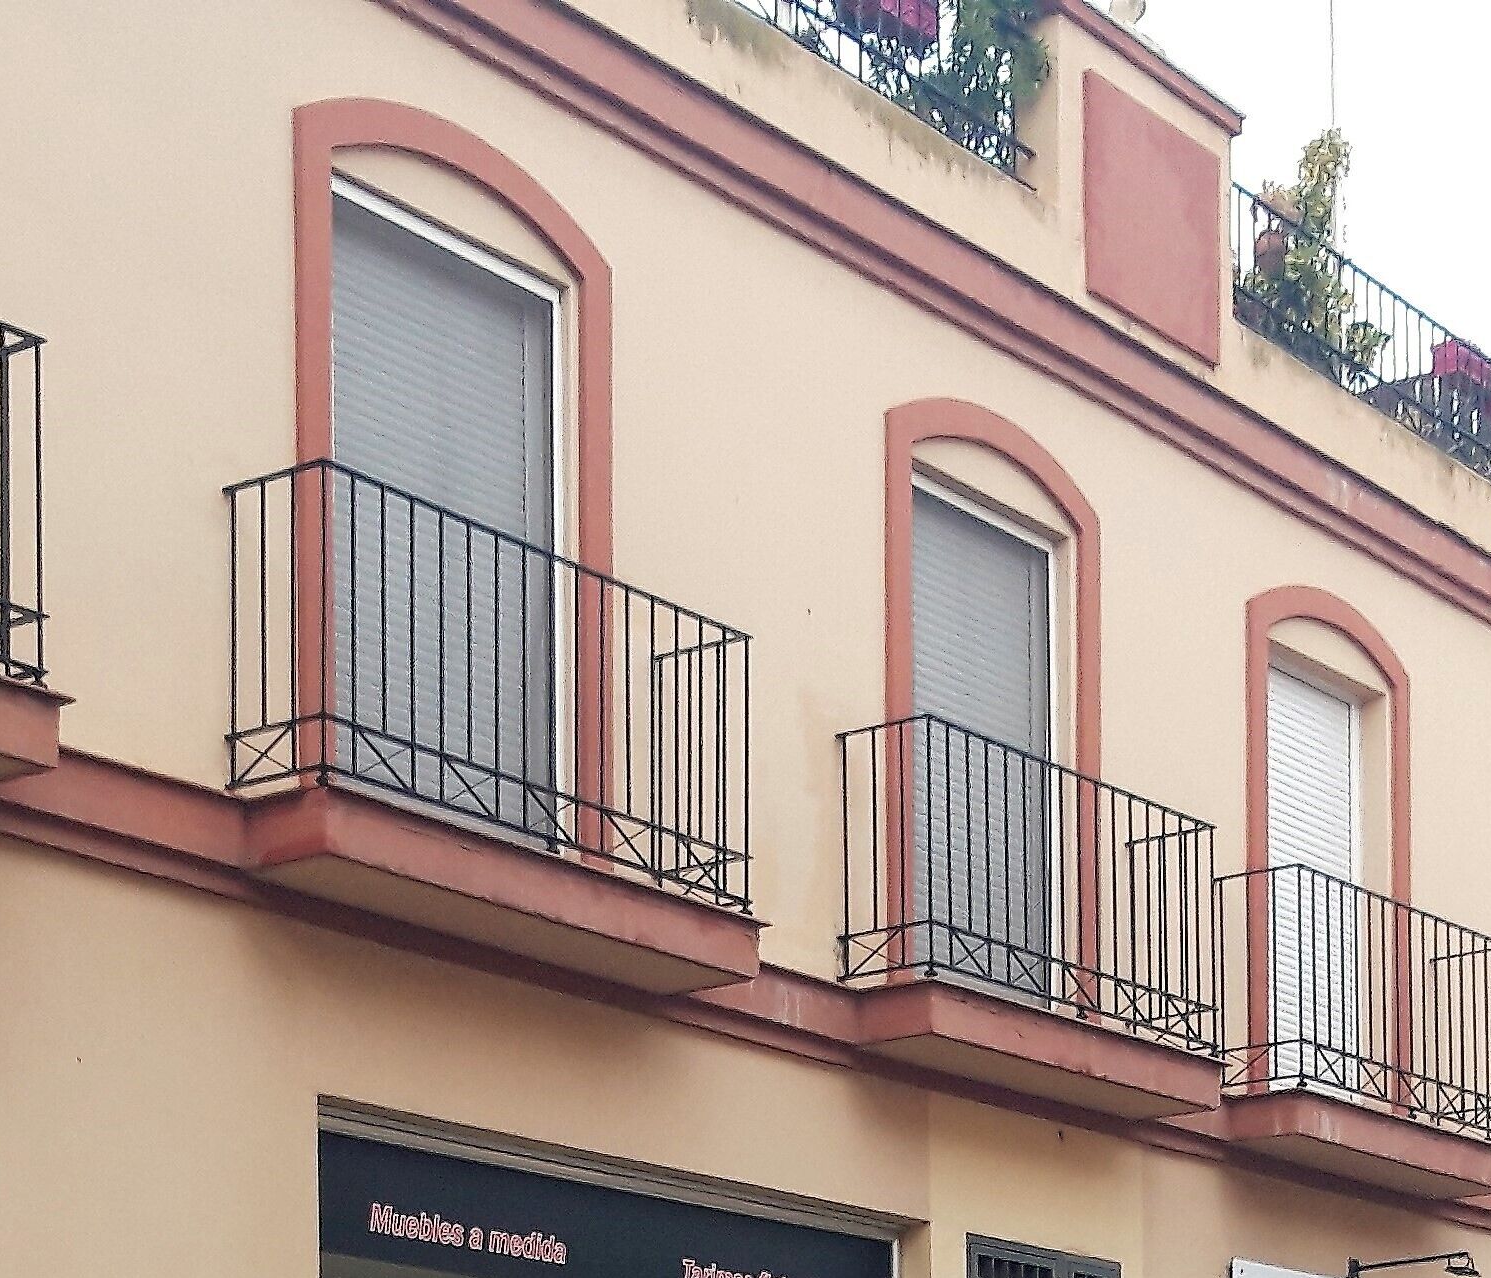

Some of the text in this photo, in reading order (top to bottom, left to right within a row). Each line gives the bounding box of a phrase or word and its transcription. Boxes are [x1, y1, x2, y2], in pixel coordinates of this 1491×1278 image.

[369, 1202, 568, 1265] Muebles a medida
